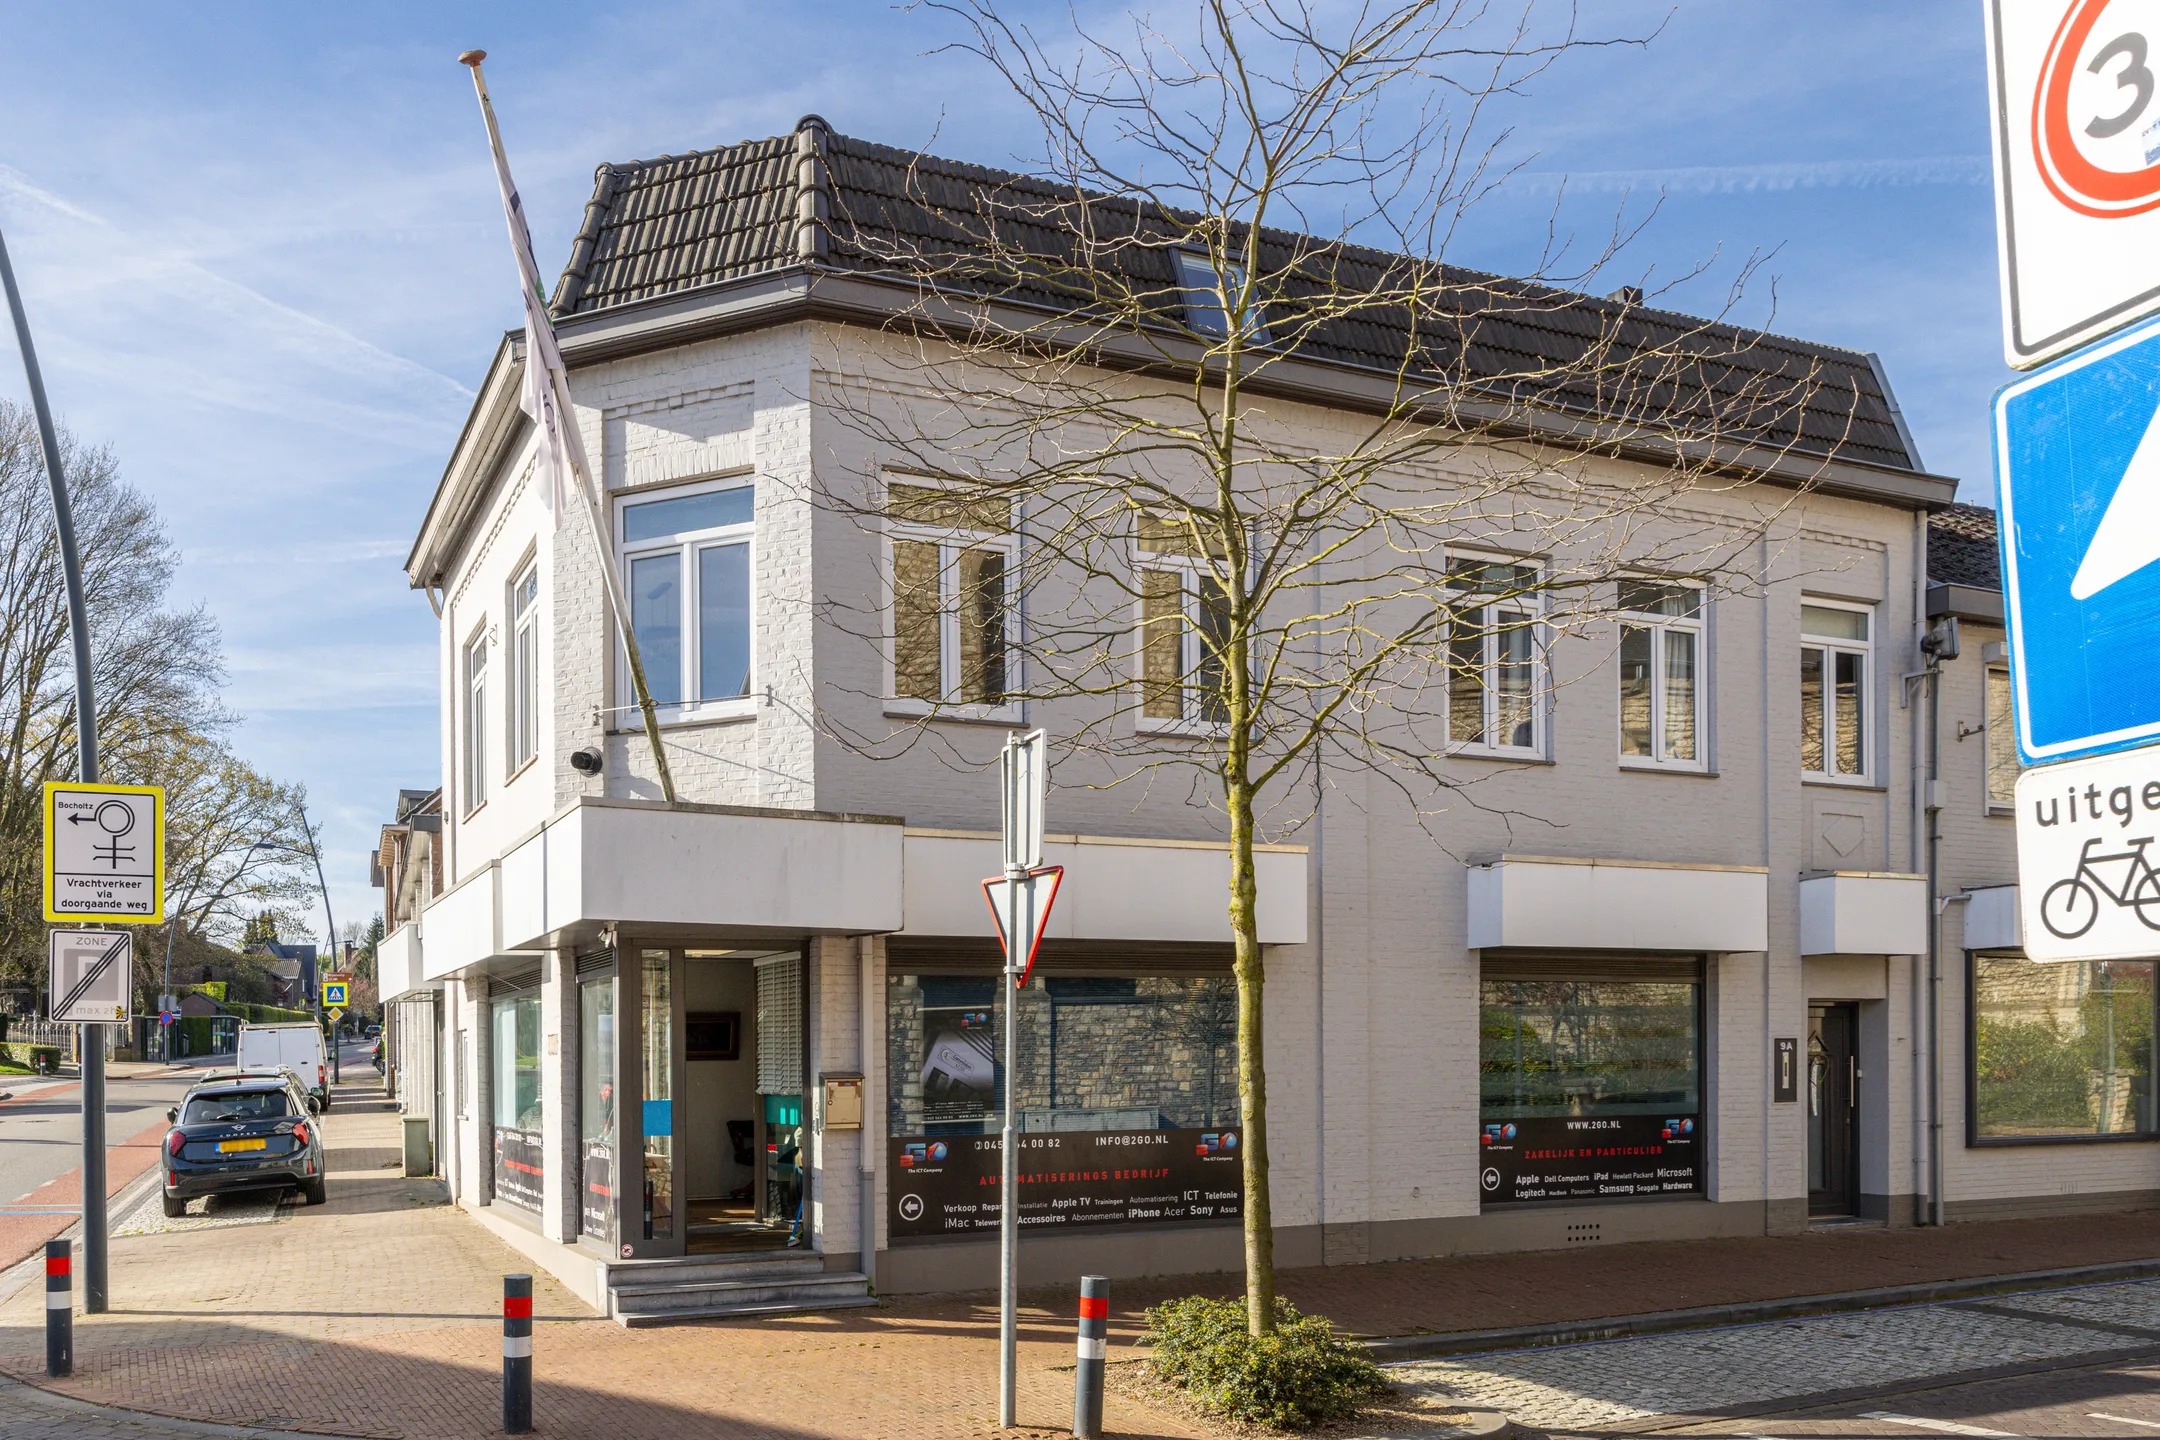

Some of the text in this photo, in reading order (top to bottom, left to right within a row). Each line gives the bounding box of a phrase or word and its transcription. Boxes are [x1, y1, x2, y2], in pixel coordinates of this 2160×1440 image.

[2084, 31, 2155, 139] 3
[58, 801, 94, 810] Bocholtz
[2035, 780, 2160, 828] uitge
[66, 878, 142, 889] Vrachtverkeer
[97, 890, 112, 898] via
[61, 899, 147, 911] doorgaande weg
[76, 937, 107, 946] ZONE
[76, 1006, 100, 1014] max
[1780, 1041, 1793, 1050] 9A
[1567, 1120, 1621, 1130] WWW.2GO.NL
[1031, 1139, 1044, 1148] 00
[1048, 1138, 1060, 1148] 82
[1095, 1135, 1169, 1146] INFO@2GO.NL
[1524, 1146, 1662, 1159] ZAKELIJK EN PARTICULIER
[1115, 1168, 1170, 1180] BEDRIJF
[1515, 1174, 1539, 1185] Apple
[1544, 1175, 1557, 1183] Dell
[1557, 1174, 1590, 1183] Computers
[1593, 1172, 1609, 1180] iPad
[1657, 1167, 1693, 1178] Microsoft
[1515, 1188, 1545, 1199] Logitech
[1599, 1184, 1634, 1194] Samsung
[1637, 1184, 1659, 1192] Seagate
[1662, 1182, 1693, 1190] Hardware
[943, 1204, 977, 1213] Verkoop
[982, 1203, 1002, 1211] Repar
[1051, 1198, 1077, 1209] Apple
[1079, 1197, 1091, 1206] TV
[1094, 1198, 1123, 1206] Trainingen
[1129, 1195, 1178, 1204] Automatisering
[1183, 1190, 1199, 1201] ICT
[1204, 1191, 1238, 1200] Telefonie
[945, 1205, 1238, 1228] iMac Telewer Accessoires Abonnementen iPhone Acer Sony Asus
